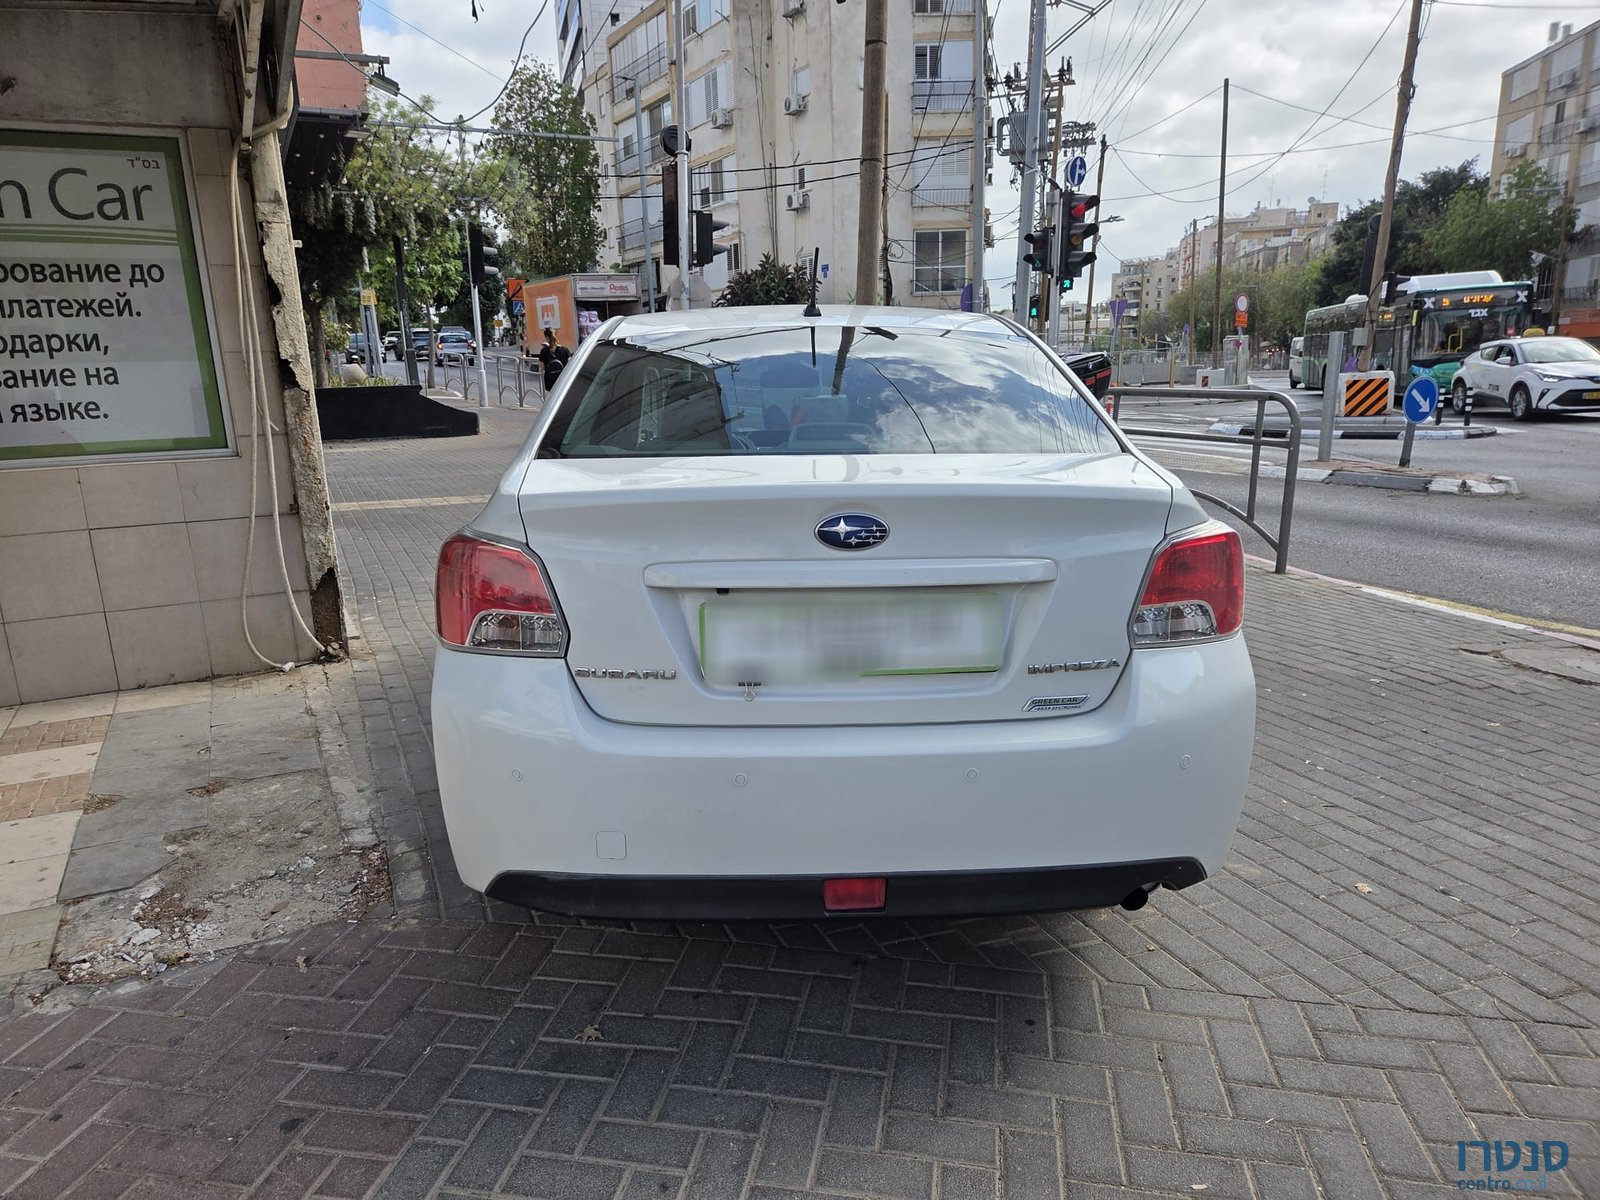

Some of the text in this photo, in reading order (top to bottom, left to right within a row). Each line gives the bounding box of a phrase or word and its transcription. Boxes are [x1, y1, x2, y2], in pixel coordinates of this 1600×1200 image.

[126, 156, 161, 169] בס"ד
[48, 167, 152, 221] Car
[129, 263, 165, 288] до
[0, 366, 120, 389] ание на
[10, 400, 109, 423] языке.
[574, 667, 677, 680] SUBARU
[1027, 658, 1120, 675] IMPREZA
